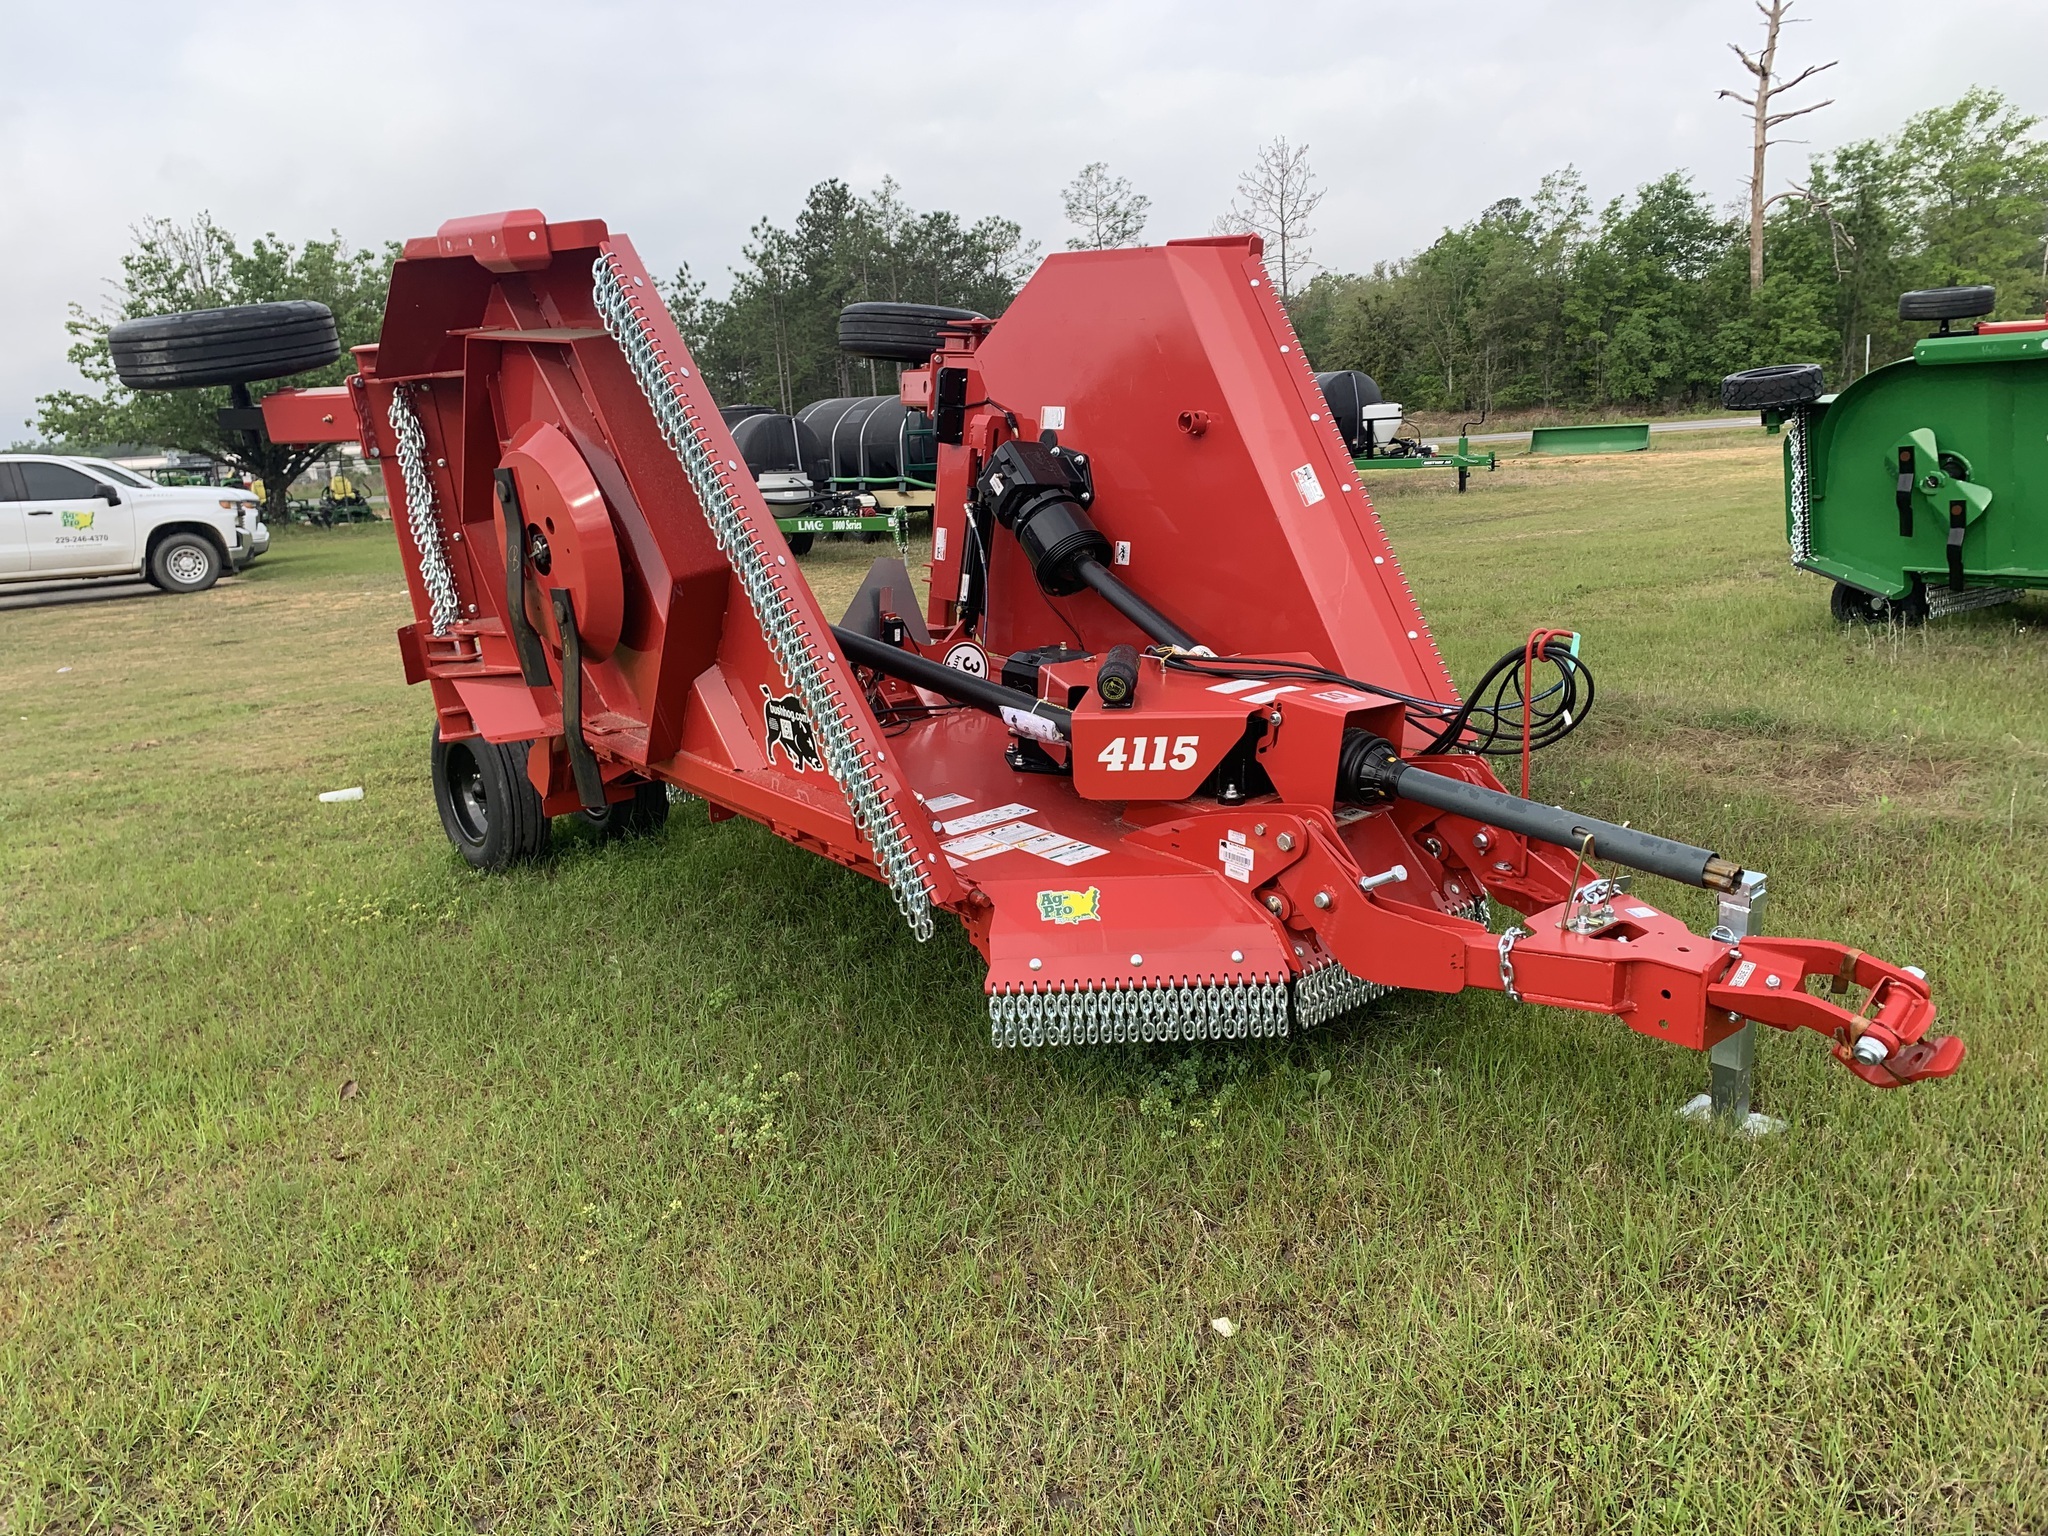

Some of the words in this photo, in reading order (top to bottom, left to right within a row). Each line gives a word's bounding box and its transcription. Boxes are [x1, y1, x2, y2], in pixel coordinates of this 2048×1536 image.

[63, 519, 80, 527] Pro
[832, 519, 846, 531] 1000
[845, 519, 862, 530] Series
[769, 702, 809, 723] bushhog.com
[1097, 736, 1200, 771] 4115
[1041, 893, 1069, 907] Ag-
[1042, 905, 1073, 918] Pro
